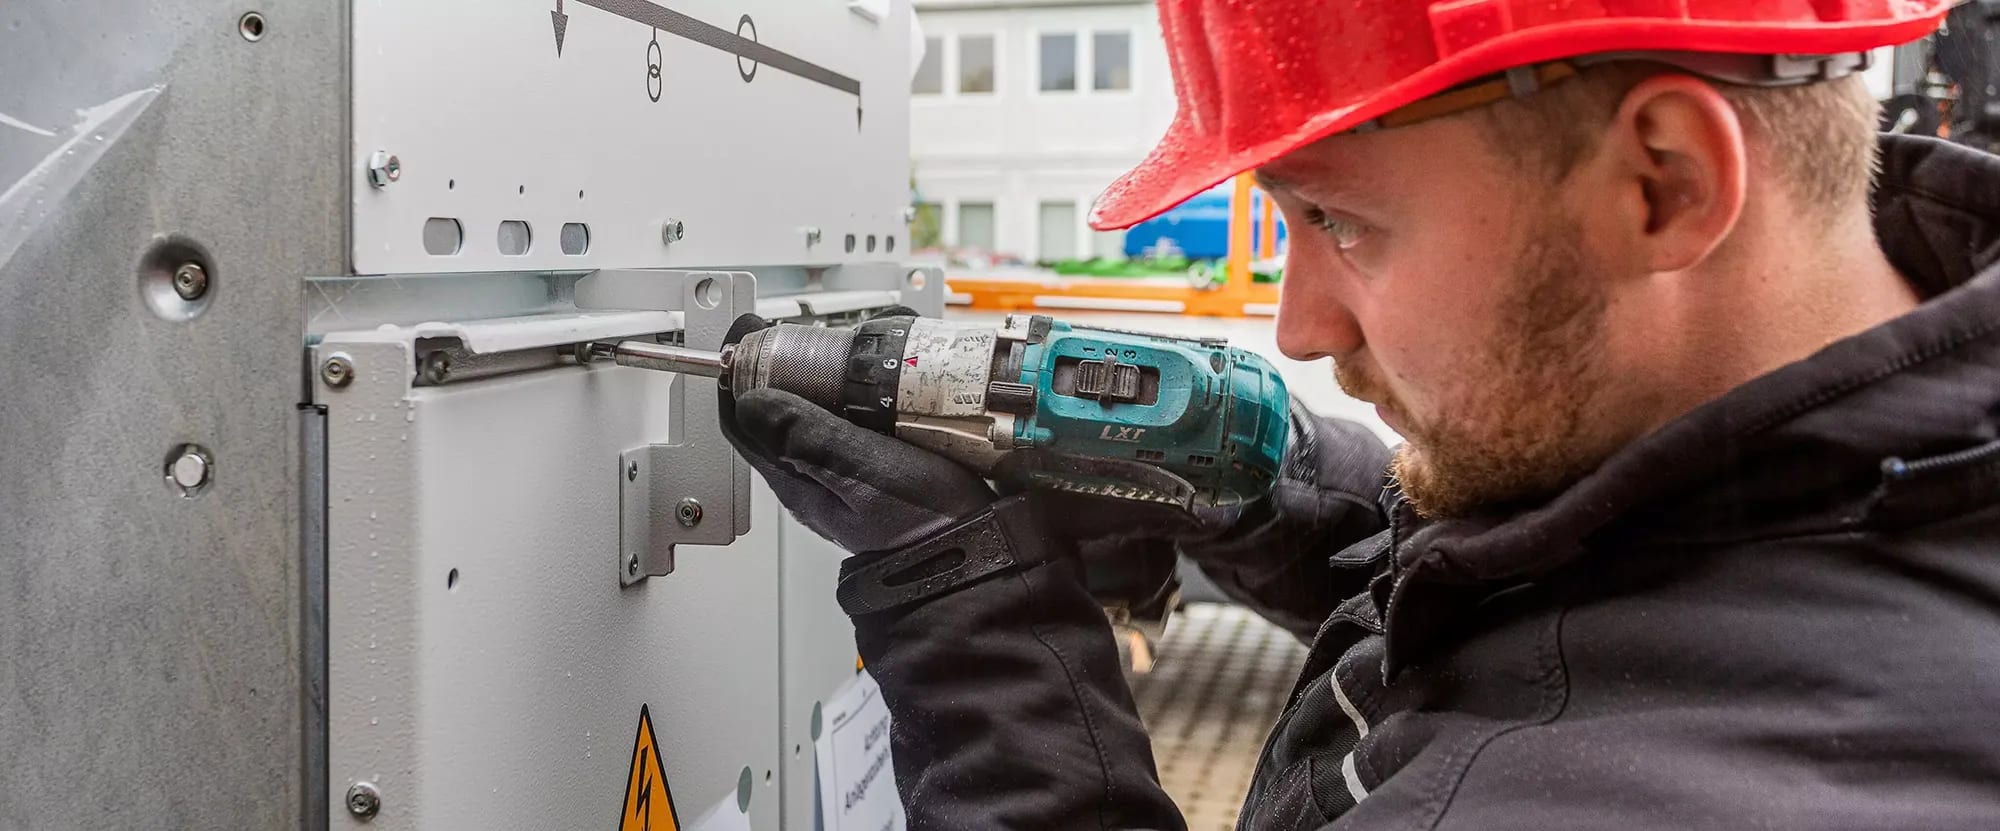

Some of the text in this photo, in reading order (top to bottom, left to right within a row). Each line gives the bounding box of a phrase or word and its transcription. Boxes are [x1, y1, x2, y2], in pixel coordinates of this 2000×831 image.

[1104, 347, 1118, 357] 2
[1123, 349, 1137, 359] 3
[882, 358, 898, 370] 6
[880, 395, 893, 409] 4
[1098, 424, 1147, 441] LXT
